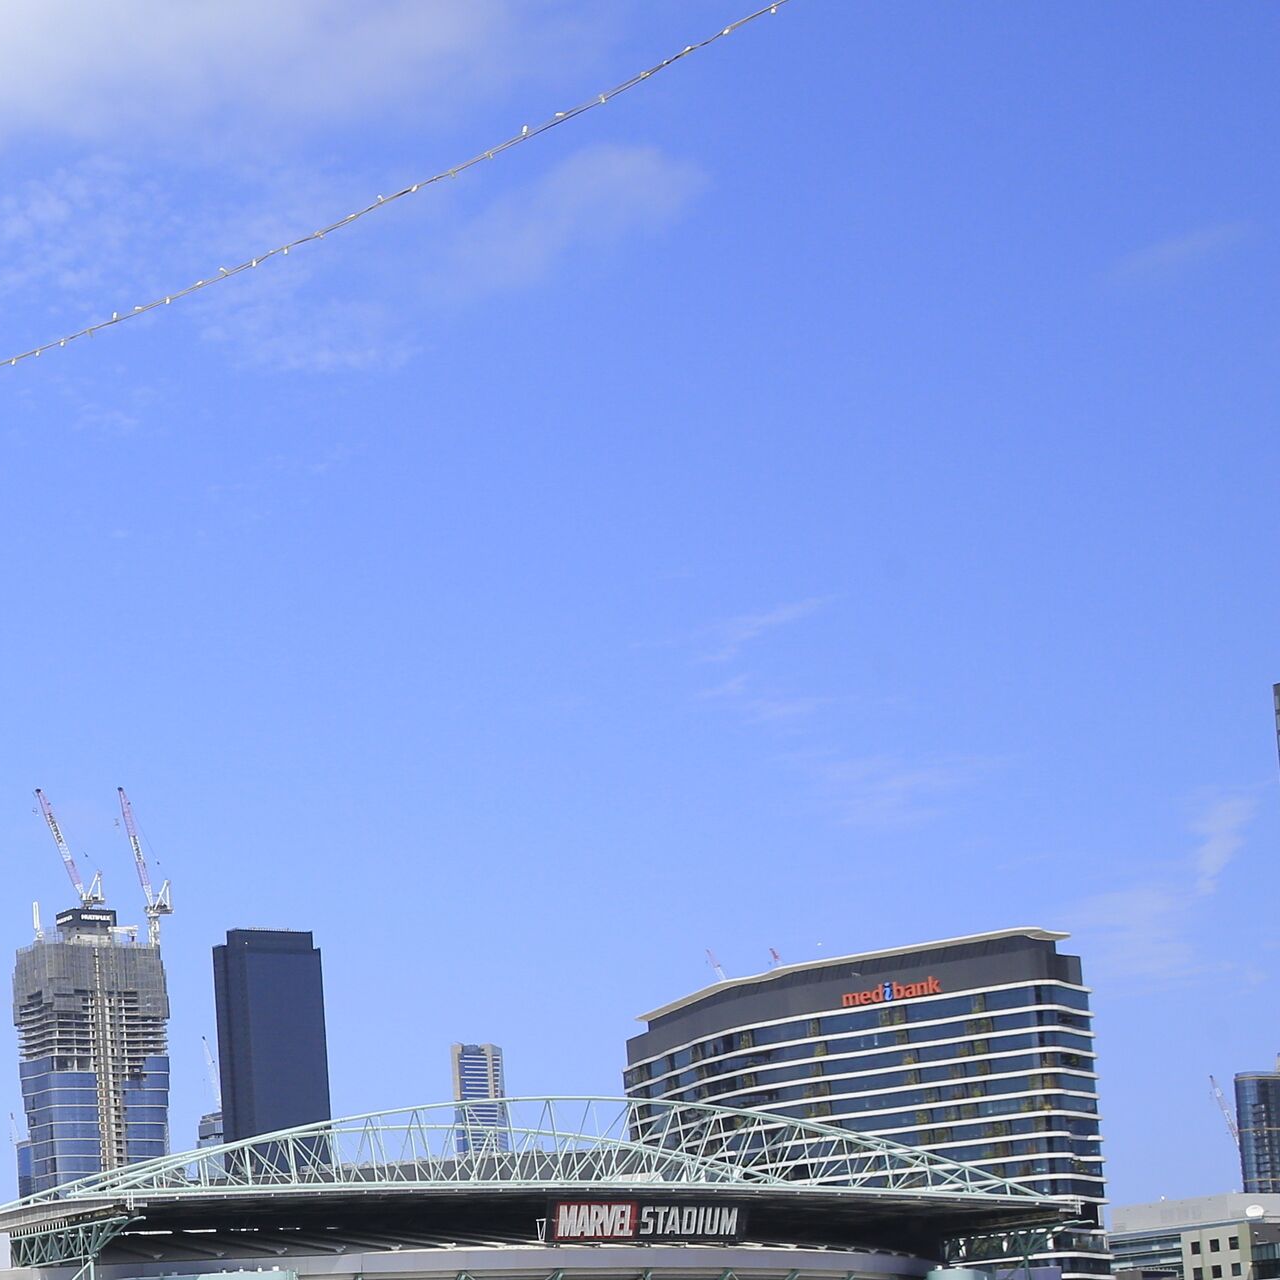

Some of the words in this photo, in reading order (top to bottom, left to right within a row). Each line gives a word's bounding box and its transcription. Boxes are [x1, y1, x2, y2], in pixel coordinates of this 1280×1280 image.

[842, 976, 943, 1006] medibank
[557, 1205, 633, 1237] MARVEL
[639, 1206, 738, 1235] STADIUM
